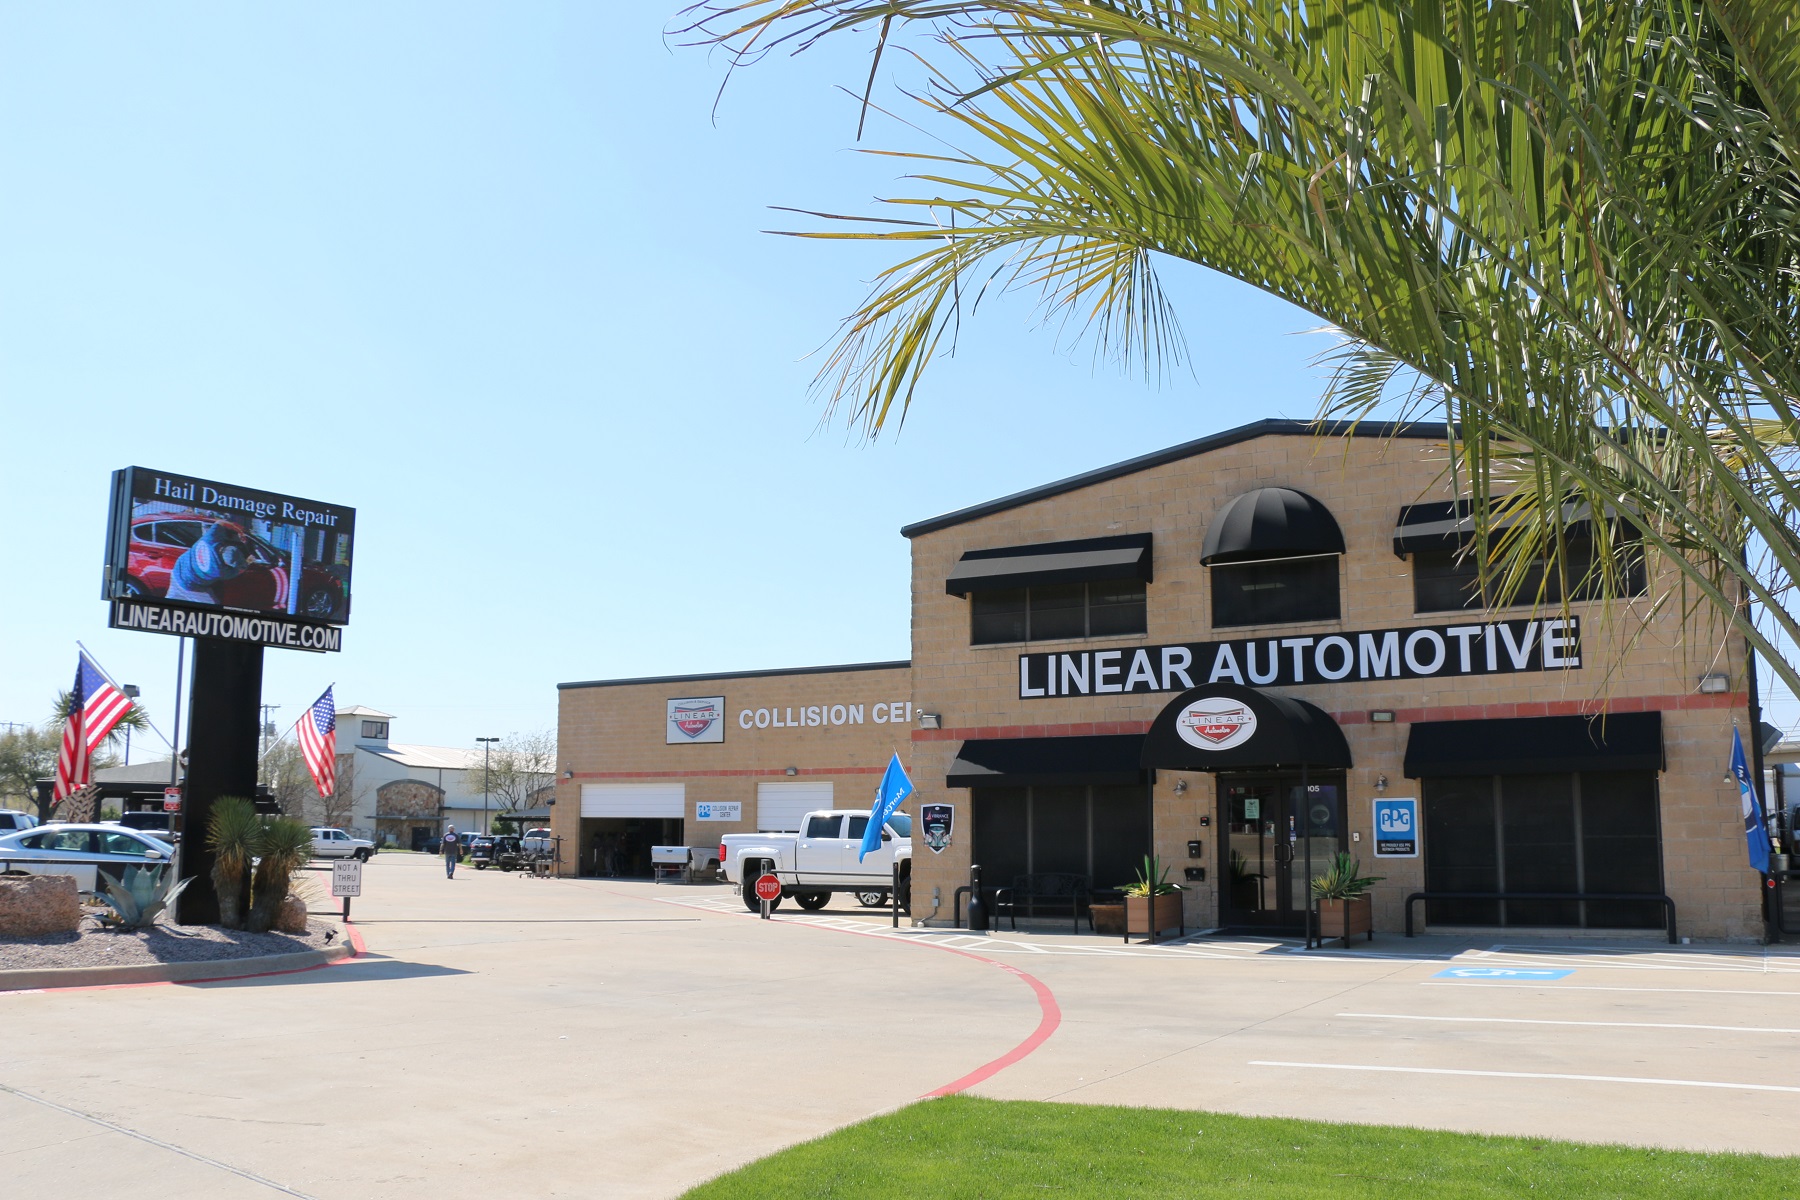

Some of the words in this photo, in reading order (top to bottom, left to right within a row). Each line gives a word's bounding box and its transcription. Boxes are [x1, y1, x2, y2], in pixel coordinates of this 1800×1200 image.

[154, 478, 195, 500] Hail
[202, 487, 277, 517] Damage
[282, 502, 338, 527] Repair
[118, 603, 339, 649] LINEARAUTOMOTIVE.COM
[1021, 646, 1195, 697] LINEAR
[1208, 619, 1579, 685] AUTOMOTIVE
[739, 704, 864, 729] COLLISION
[1188, 716, 1245, 724] LINEAR
[1382, 809, 1409, 827] PPG
[758, 882, 778, 892] STOP
